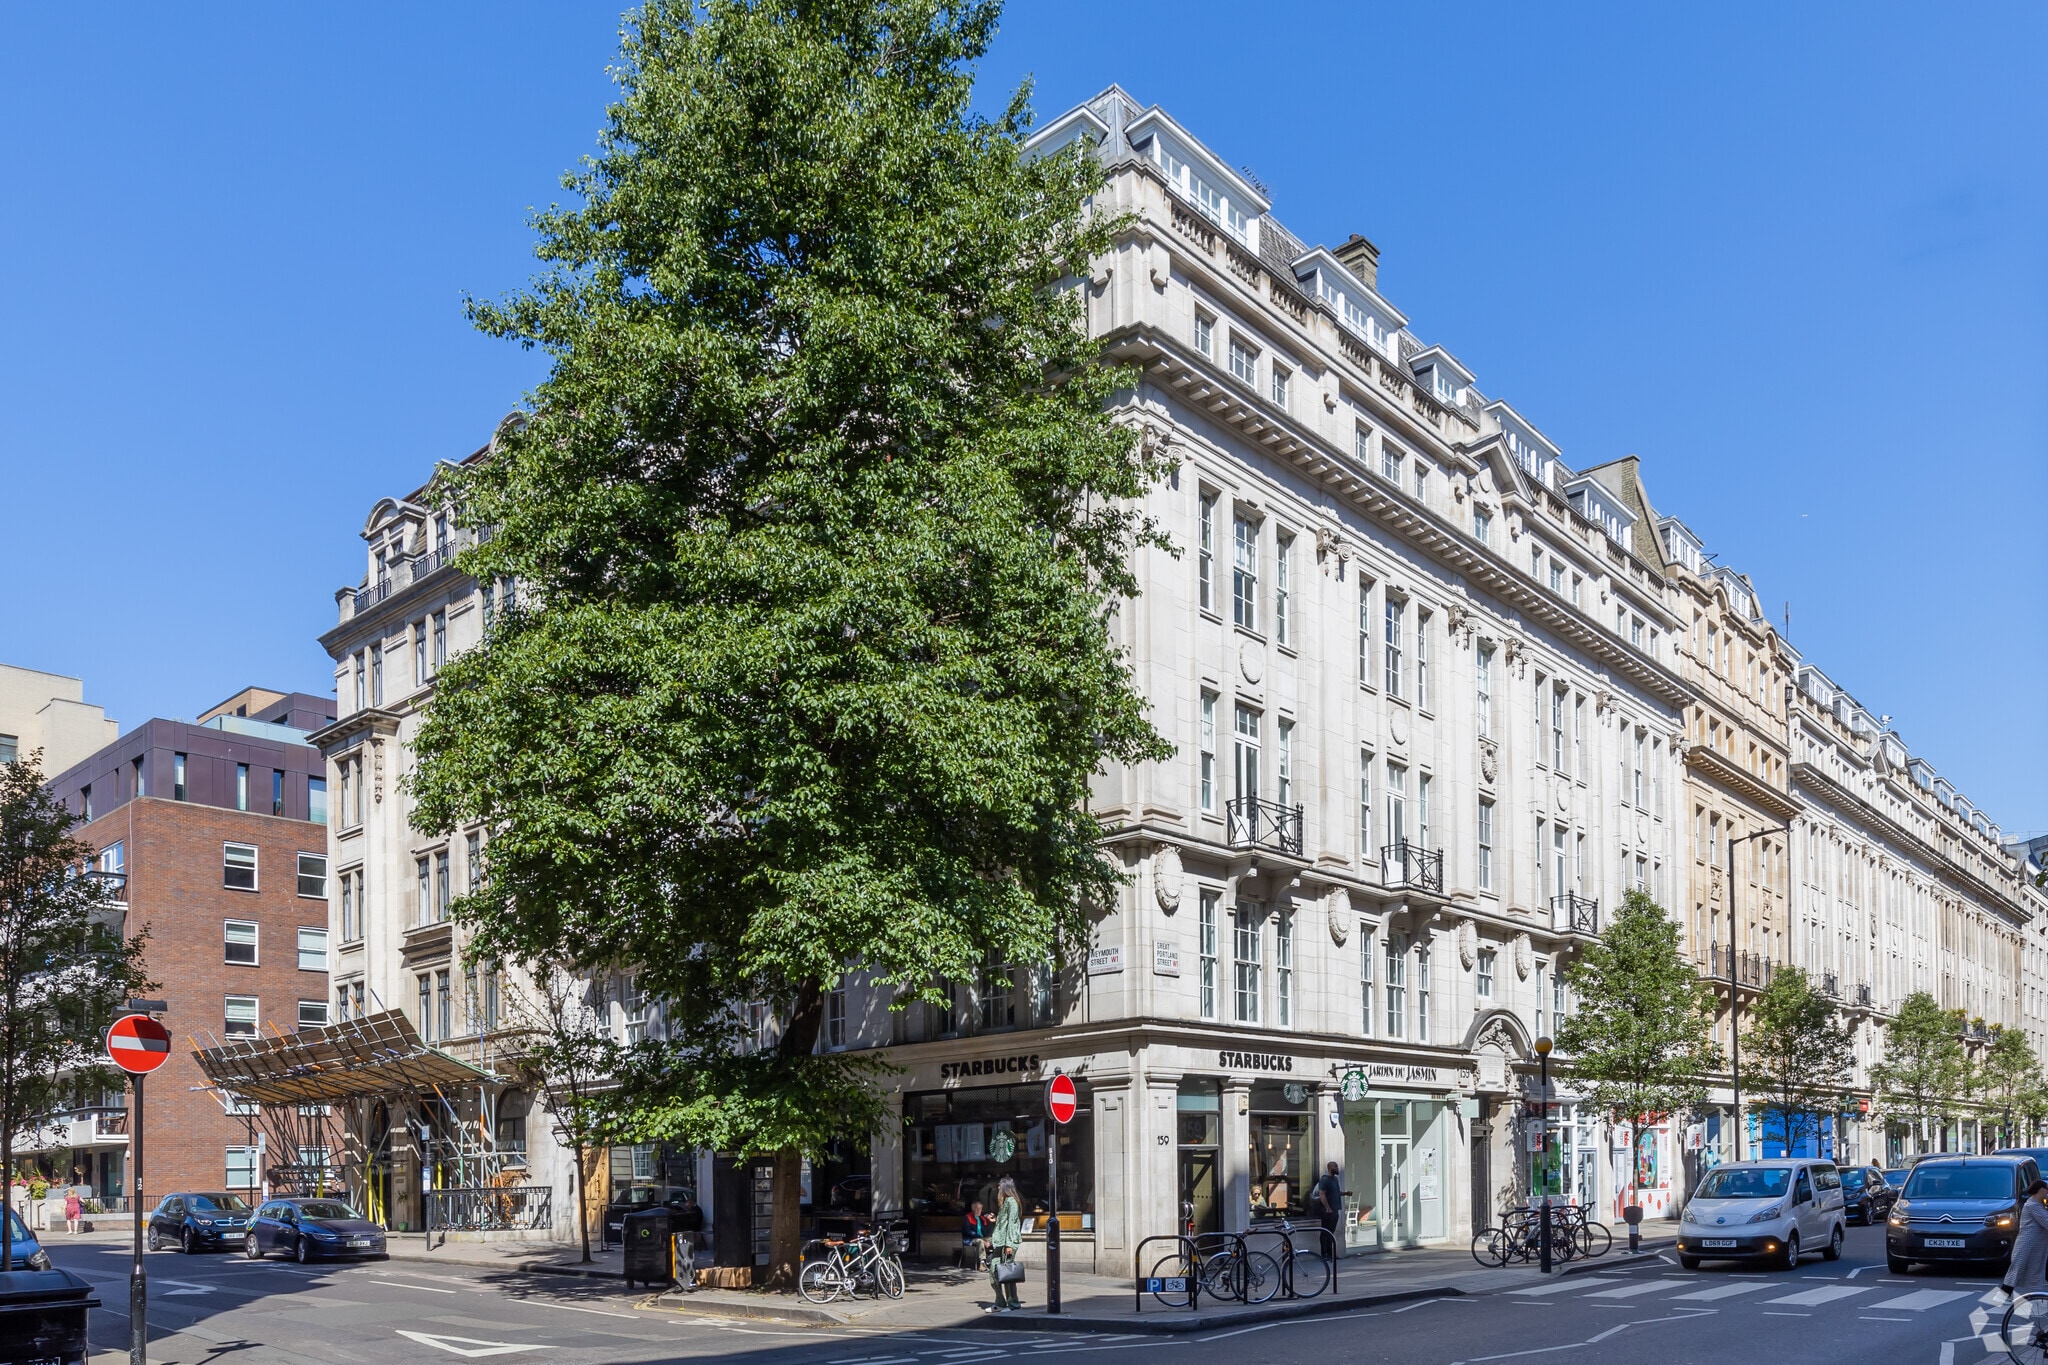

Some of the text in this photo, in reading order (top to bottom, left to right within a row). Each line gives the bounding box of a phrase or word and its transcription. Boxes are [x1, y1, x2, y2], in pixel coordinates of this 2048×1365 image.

[1157, 942, 1170, 950] GREAT
[1090, 947, 1119, 958] WEYMOUTH
[1157, 950, 1178, 959] PORTLAND
[1090, 957, 1108, 966] STREET
[1157, 958, 1172, 966] STREET
[941, 1055, 1040, 1078] STARBUCKS
[1219, 1051, 1292, 1072] STARBUCKS
[1368, 1064, 1437, 1082] JARDIN DU JASMIN
[1157, 1136, 1169, 1145] 159
[1150, 1279, 1160, 1291] P
